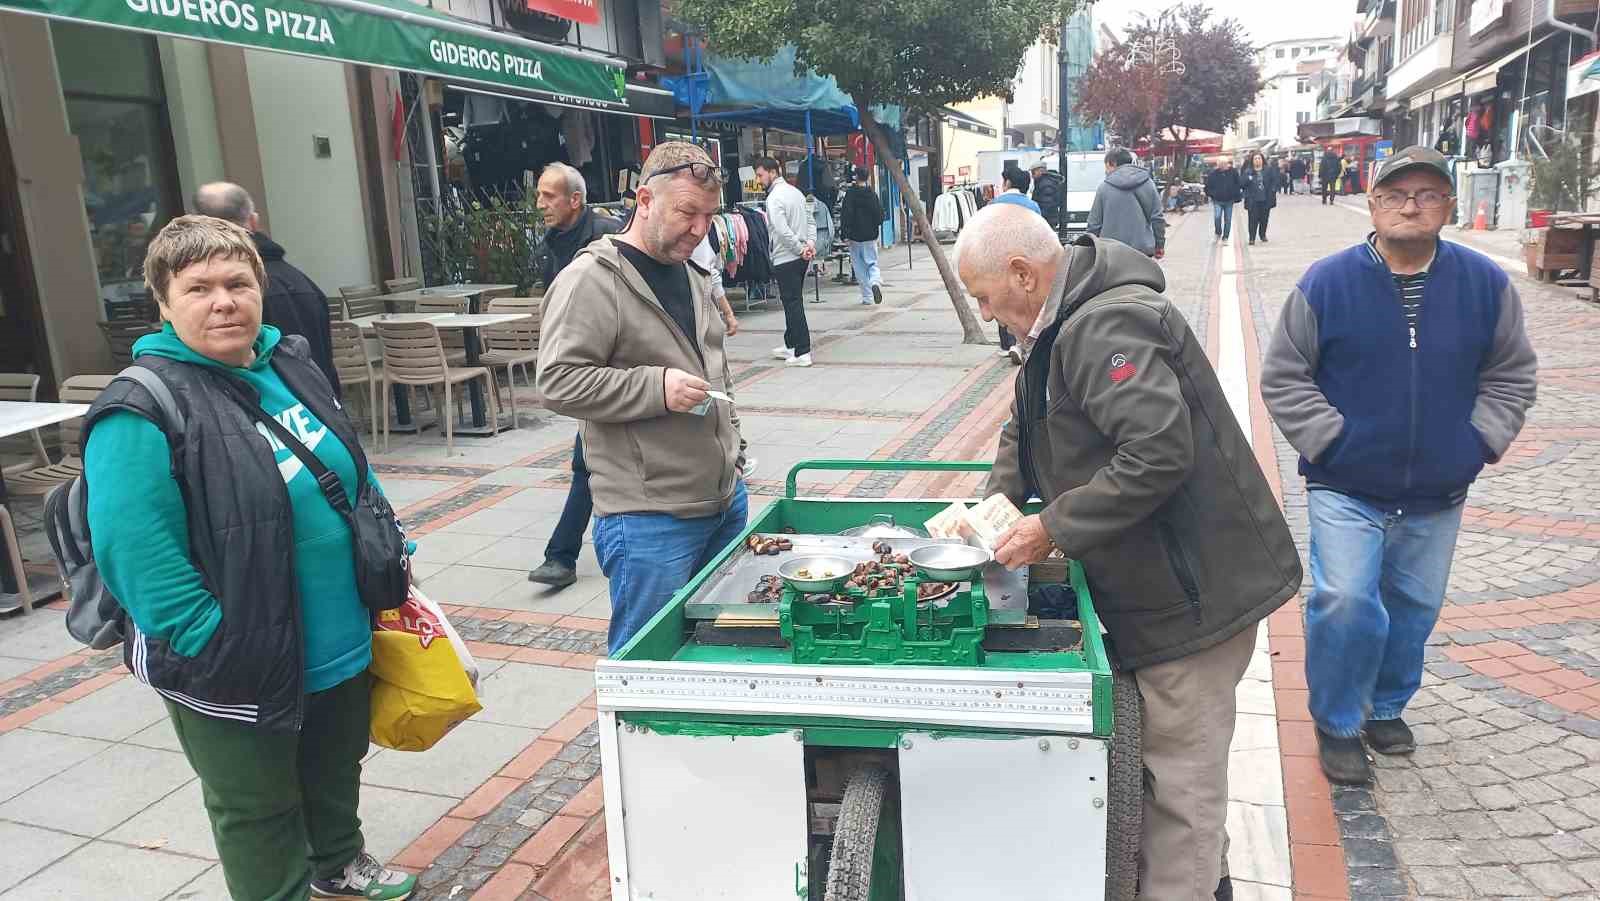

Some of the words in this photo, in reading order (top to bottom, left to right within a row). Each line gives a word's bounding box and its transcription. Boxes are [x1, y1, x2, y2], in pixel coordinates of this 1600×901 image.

[264, 8, 336, 44] PIZZA
[429, 39, 501, 72] GIDEROS
[504, 53, 544, 80] PIZZA
